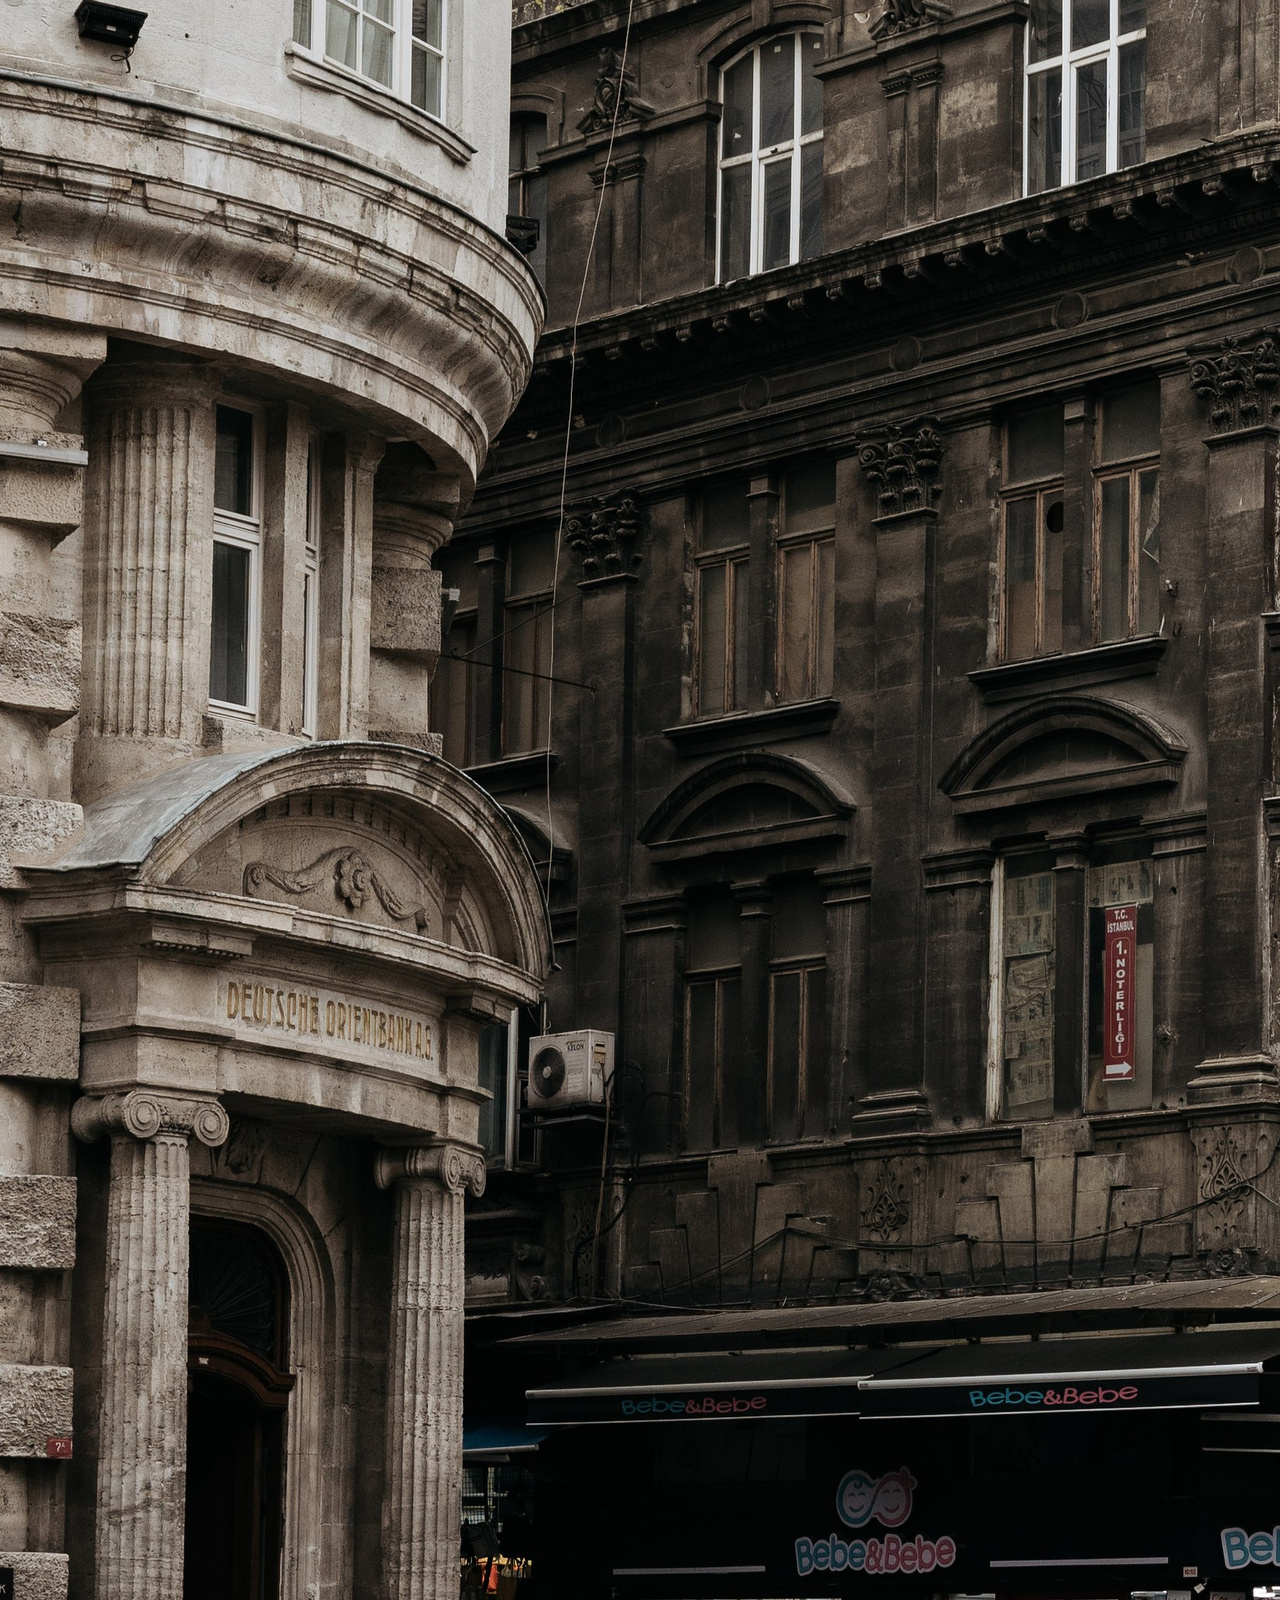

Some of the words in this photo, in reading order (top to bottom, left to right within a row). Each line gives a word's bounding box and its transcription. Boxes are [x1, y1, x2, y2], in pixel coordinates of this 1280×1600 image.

[1113, 909, 1129, 920] T.C.
[1106, 920, 1135, 934] İSTANBUL
[1115, 940, 1128, 955] 1.
[1114, 958, 1127, 1054] NOTERLİĞİ
[226, 981, 319, 1035] DEUTSCHE
[325, 1000, 412, 1055] ORIENTBANK
[414, 1021, 434, 1061] A.G.
[621, 1396, 768, 1416] Bebe&Bebe
[968, 1386, 1139, 1407] Bebe&Bebe
[795, 1533, 956, 1576] Bebe&Bebe
